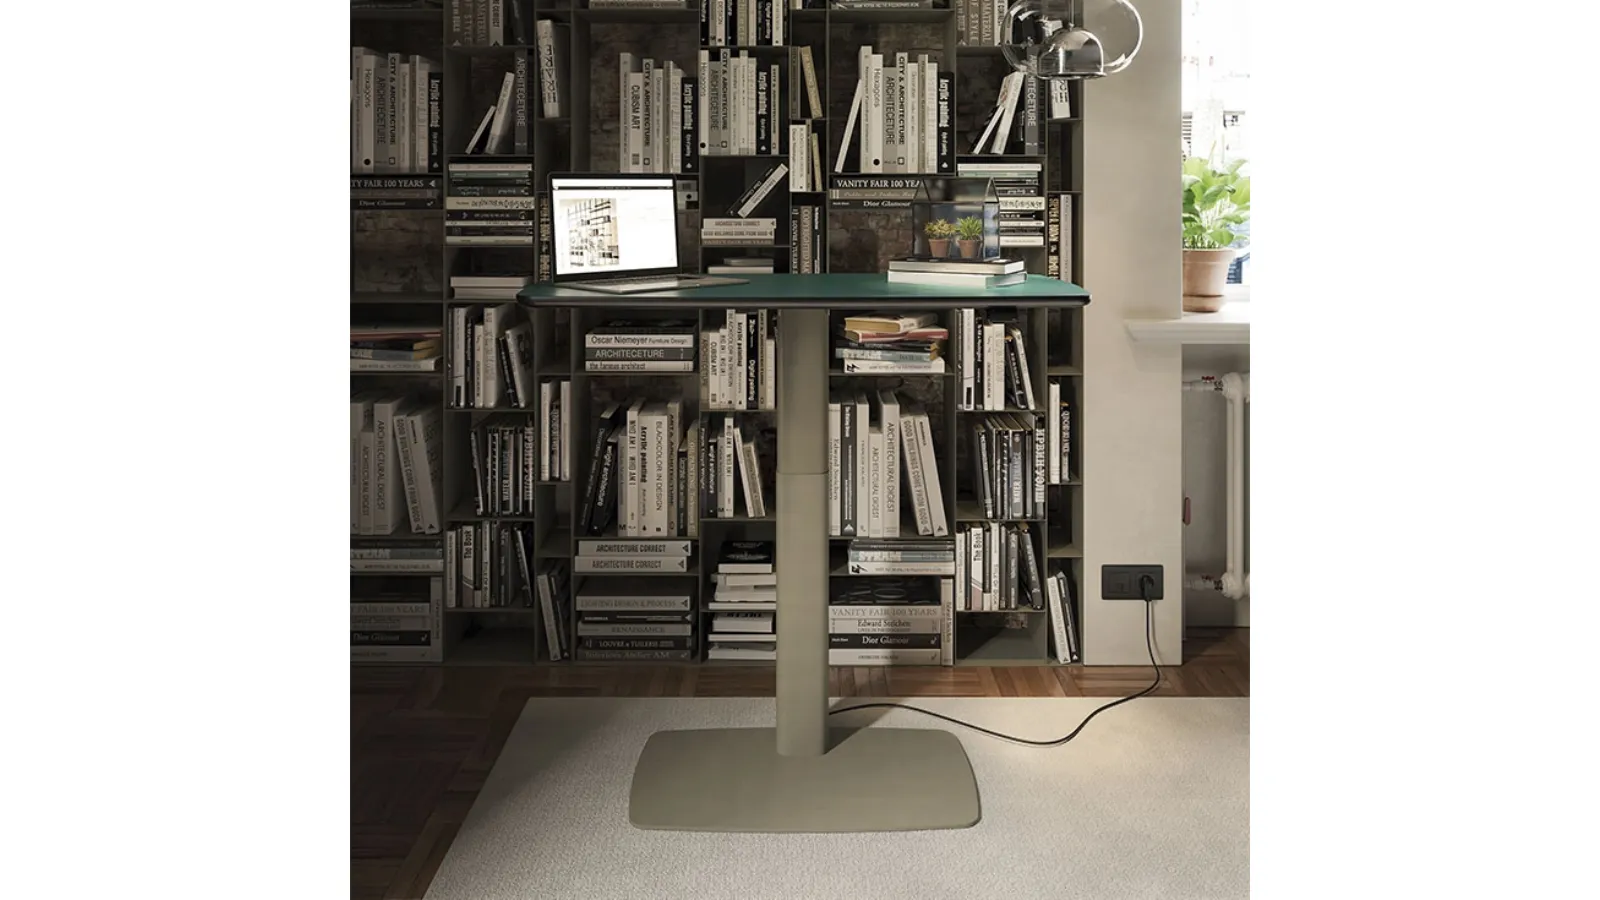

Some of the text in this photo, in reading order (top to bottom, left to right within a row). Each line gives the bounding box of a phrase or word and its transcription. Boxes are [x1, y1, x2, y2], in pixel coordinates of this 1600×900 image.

[631, 115, 640, 130] ART
[364, 179, 383, 188] FAIR
[384, 179, 397, 188] 100
[398, 179, 425, 188] YEARS
[837, 179, 869, 188] VANITY
[870, 179, 889, 188] FAIR
[890, 179, 904, 188] 100
[591, 336, 613, 345] Oscar
[614, 336, 648, 345] Niemeyer
[595, 350, 664, 358] ARCHITECETURE
[589, 362, 599, 370] the
[886, 422, 895, 513] ARCHITECTURAL DIGEST
[655, 473, 663, 481] IN
[376, 484, 386, 511] DIGEST
[596, 544, 666, 553] ARCHITECTURE CORRECT
[592, 559, 662, 569] ARCHITECTURE CORRECT
[831, 608, 866, 617] VANITY
[868, 608, 890, 617] FAIR
[907, 608, 938, 617] YEARS
[862, 635, 879, 644] Dior
